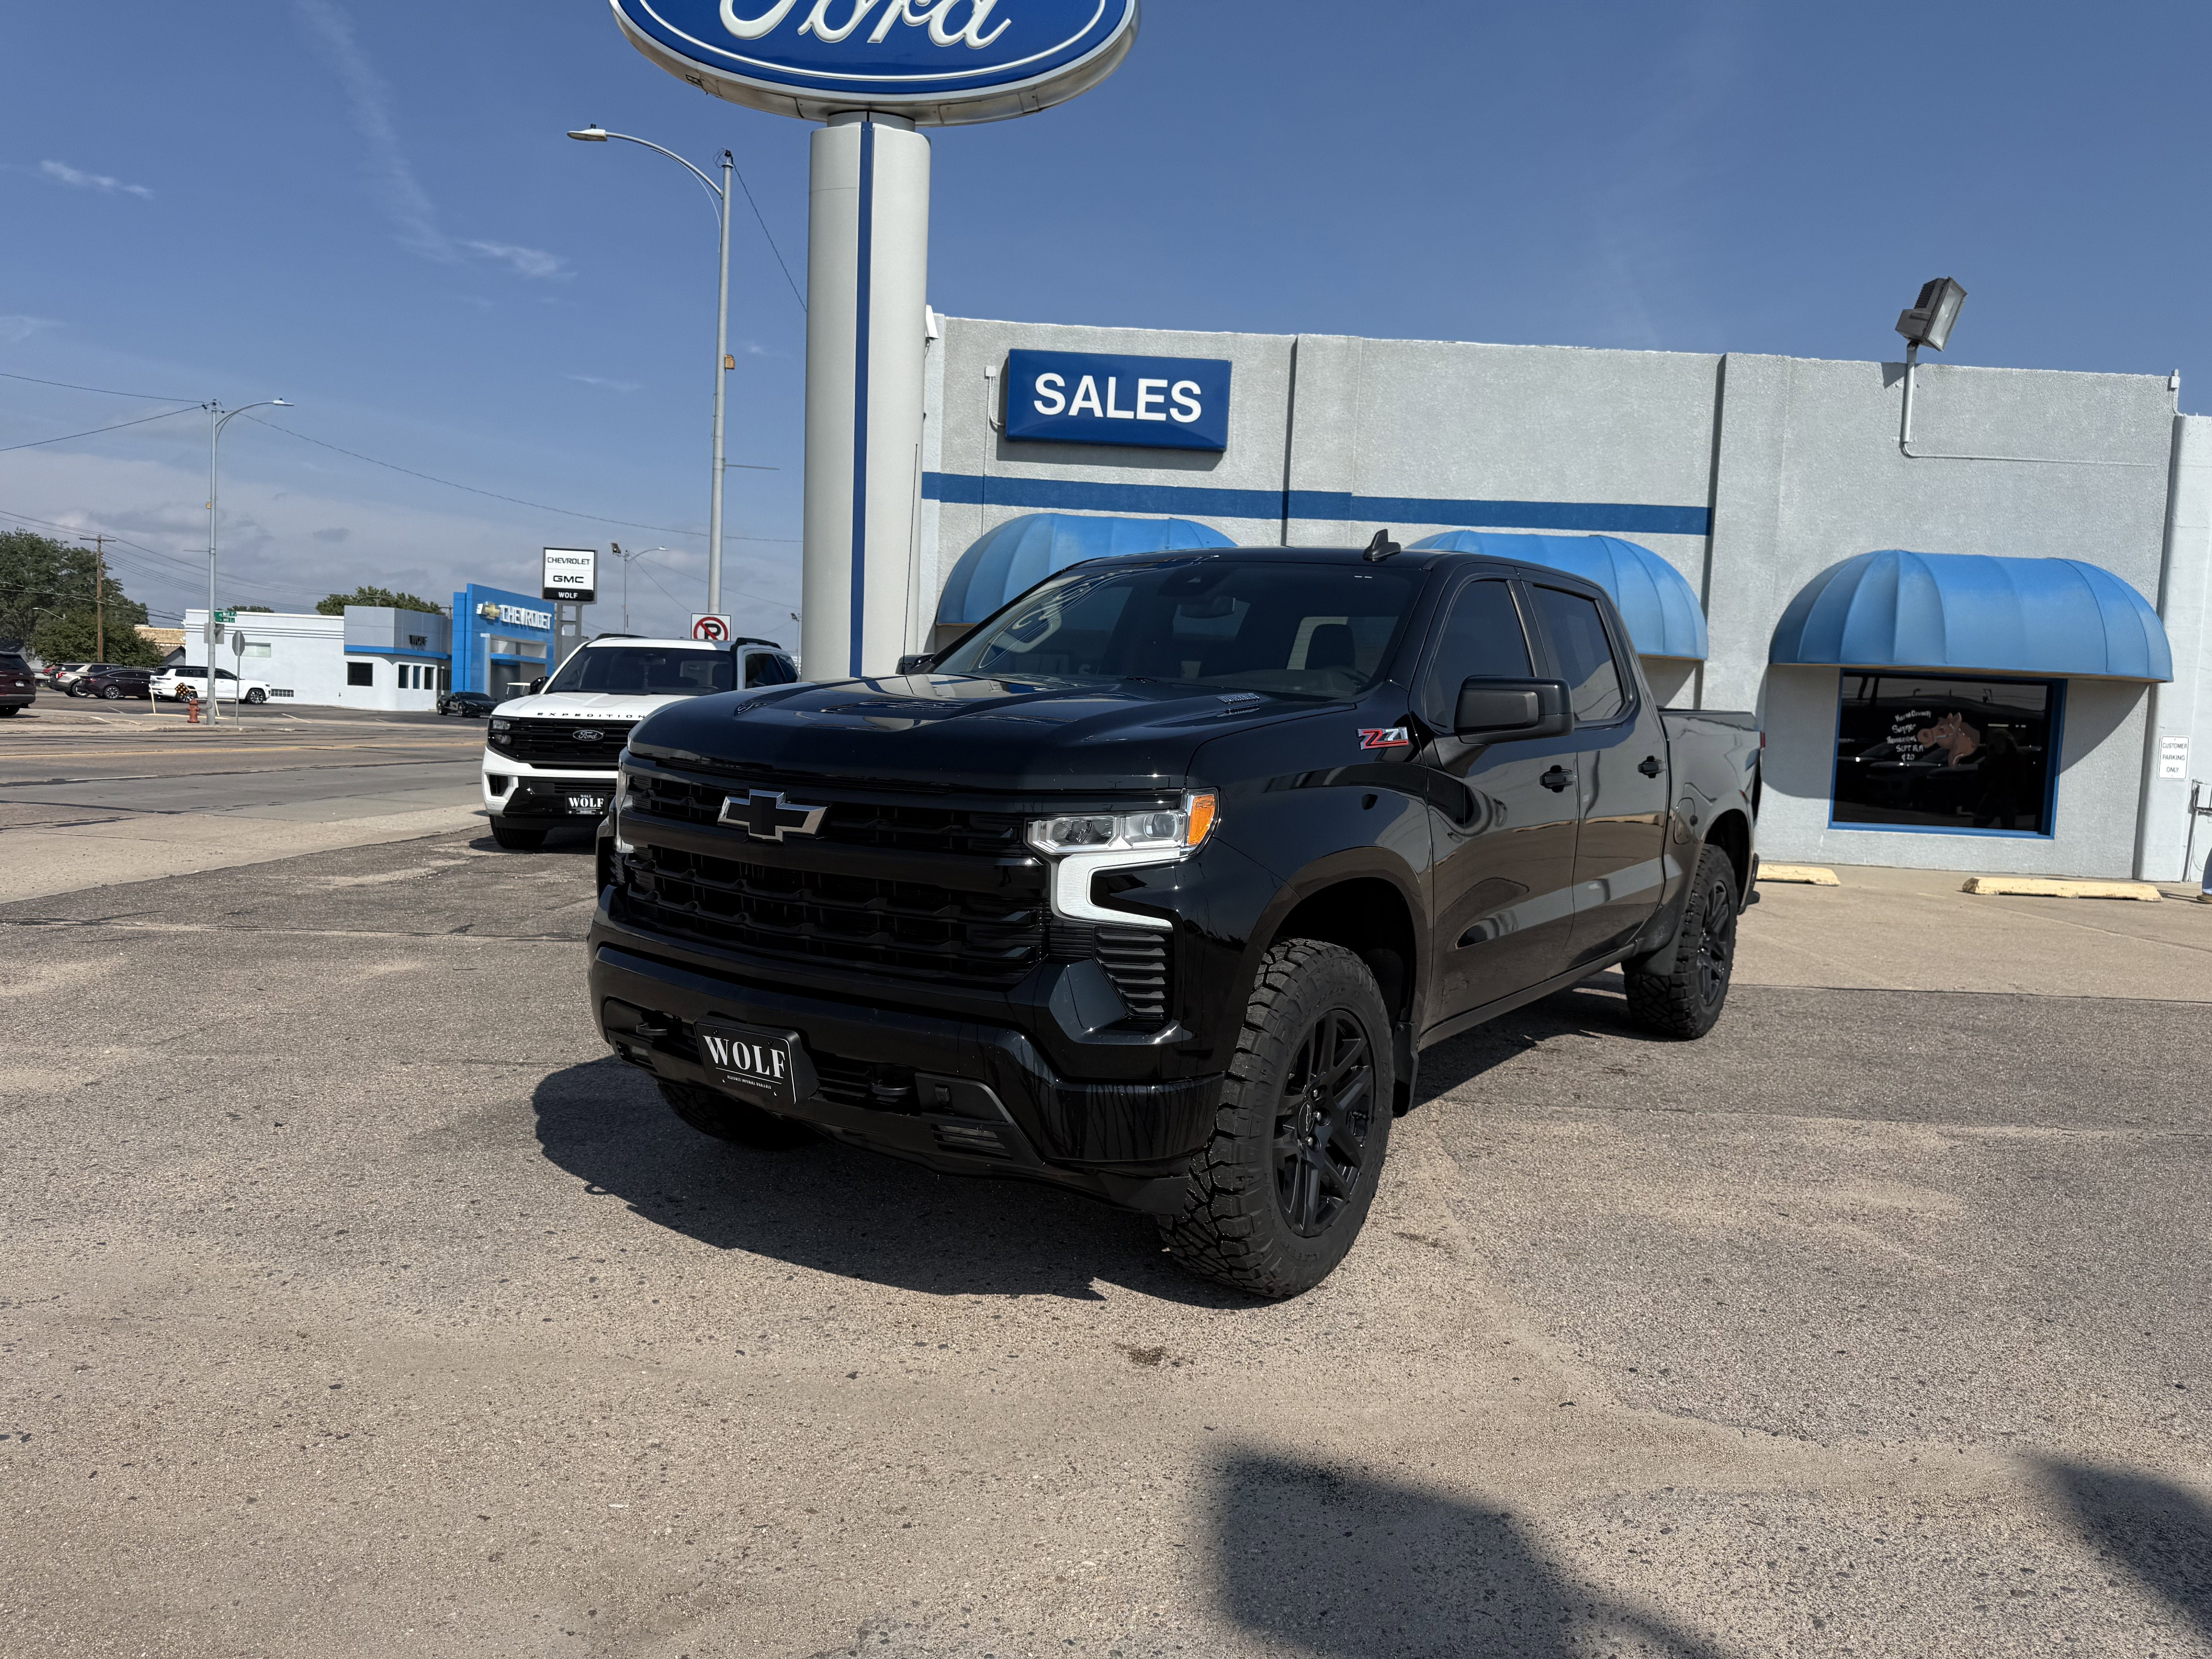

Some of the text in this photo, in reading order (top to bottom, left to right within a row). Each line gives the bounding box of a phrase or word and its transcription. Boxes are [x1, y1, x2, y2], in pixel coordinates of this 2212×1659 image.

[1034, 373, 1202, 423] SALES
[547, 557, 590, 565] CHEVROLET
[553, 575, 584, 583] GMC
[499, 605, 552, 629] CHEVROLET
[409, 635, 428, 646] WOLF
[578, 731, 598, 739] Ford
[1357, 726, 1409, 750] Z71
[568, 797, 604, 807] WOLF
[702, 1035, 785, 1079] WOLF
